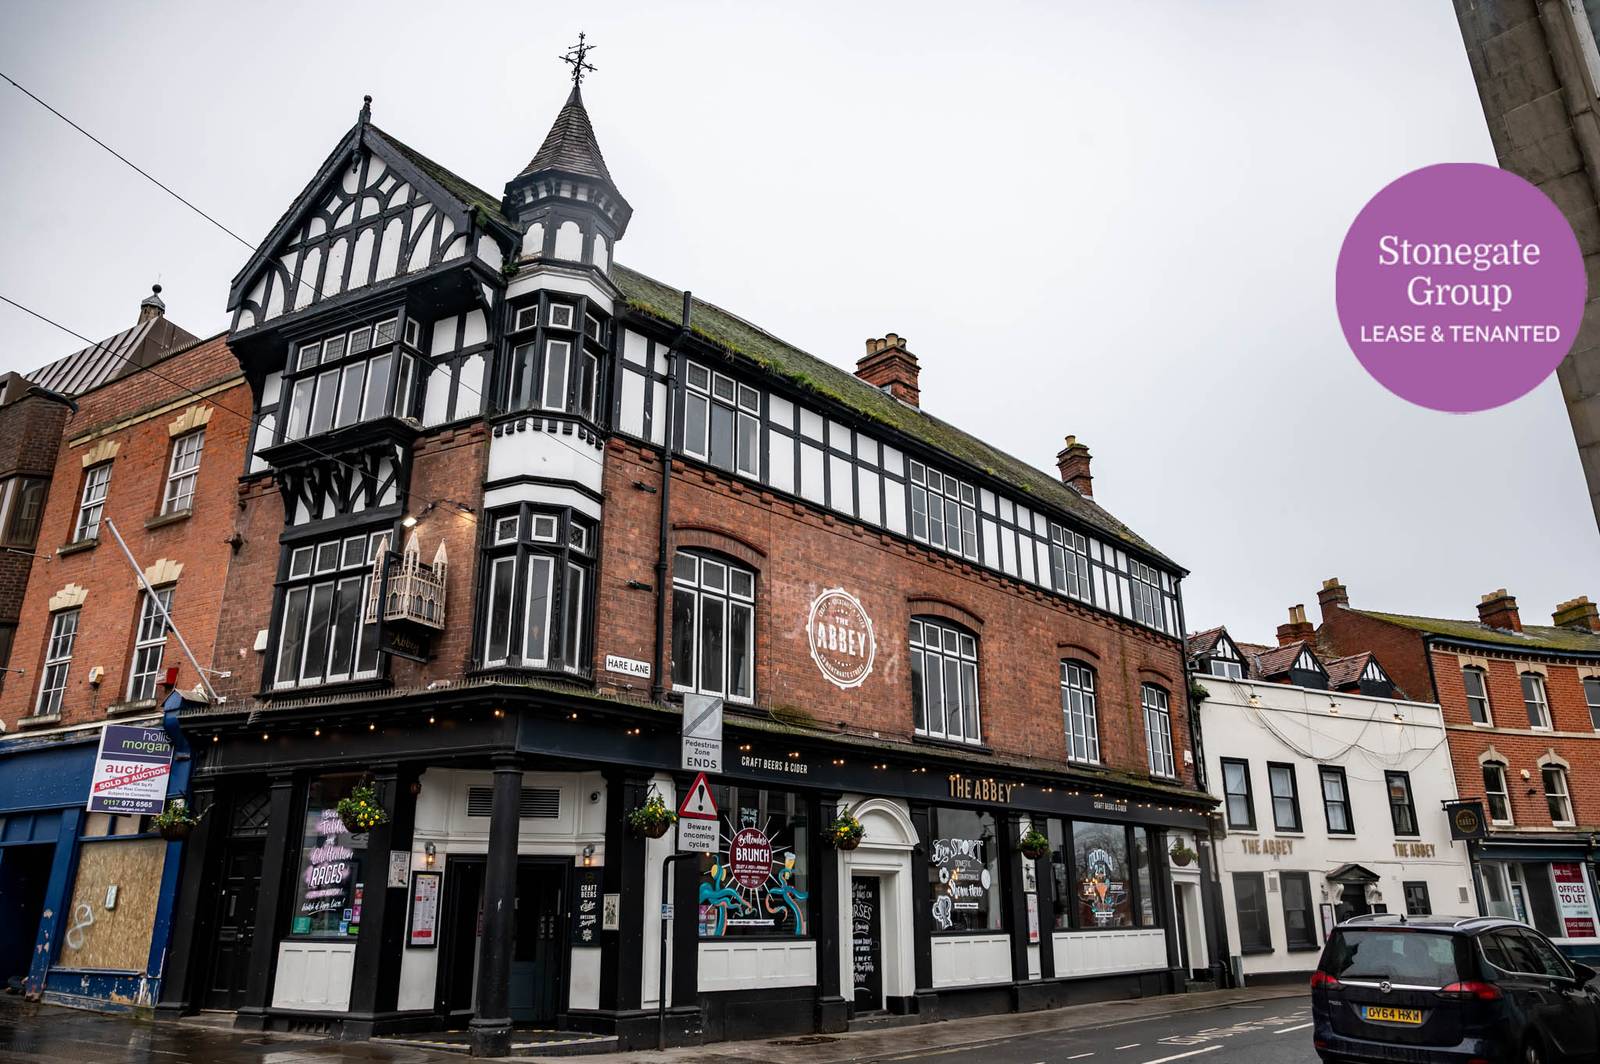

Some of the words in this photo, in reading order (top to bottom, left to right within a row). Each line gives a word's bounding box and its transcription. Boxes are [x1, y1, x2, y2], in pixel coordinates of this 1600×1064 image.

[836, 616, 849, 625] THE
[817, 622, 865, 658] ABBEY
[608, 658, 628, 670] HARE
[630, 663, 649, 674] LANE
[143, 730, 171, 743] hollis
[122, 740, 170, 753] morgan
[686, 740, 720, 750] Pedestrian
[695, 748, 710, 756] Zone
[687, 757, 717, 769] ENDS
[741, 756, 762, 768] CRAFT
[763, 759, 783, 771] BEERS
[784, 761, 789, 772] &
[790, 763, 808, 774] CIDER
[99, 778, 121, 790] SOLD
[131, 766, 167, 781] AUCTION
[949, 776, 971, 799] THE
[974, 779, 1012, 803] ABBEY
[688, 823, 711, 831] Beware
[684, 832, 715, 841] oncoming
[950, 838, 984, 864] SPORT
[1242, 839, 1261, 854] THE
[1262, 839, 1293, 855] ABBEY
[1393, 843, 1409, 858] THE
[1410, 843, 1436, 858] ABBEY
[736, 848, 770, 862] BRUNCH
[310, 863, 345, 887] RACES
[581, 884, 597, 892] CRAFT
[1558, 885, 1585, 893] OFFICES
[1560, 894, 1572, 903] TO
[1573, 894, 1586, 903] LET
[1368, 1007, 1395, 1019] OY64
